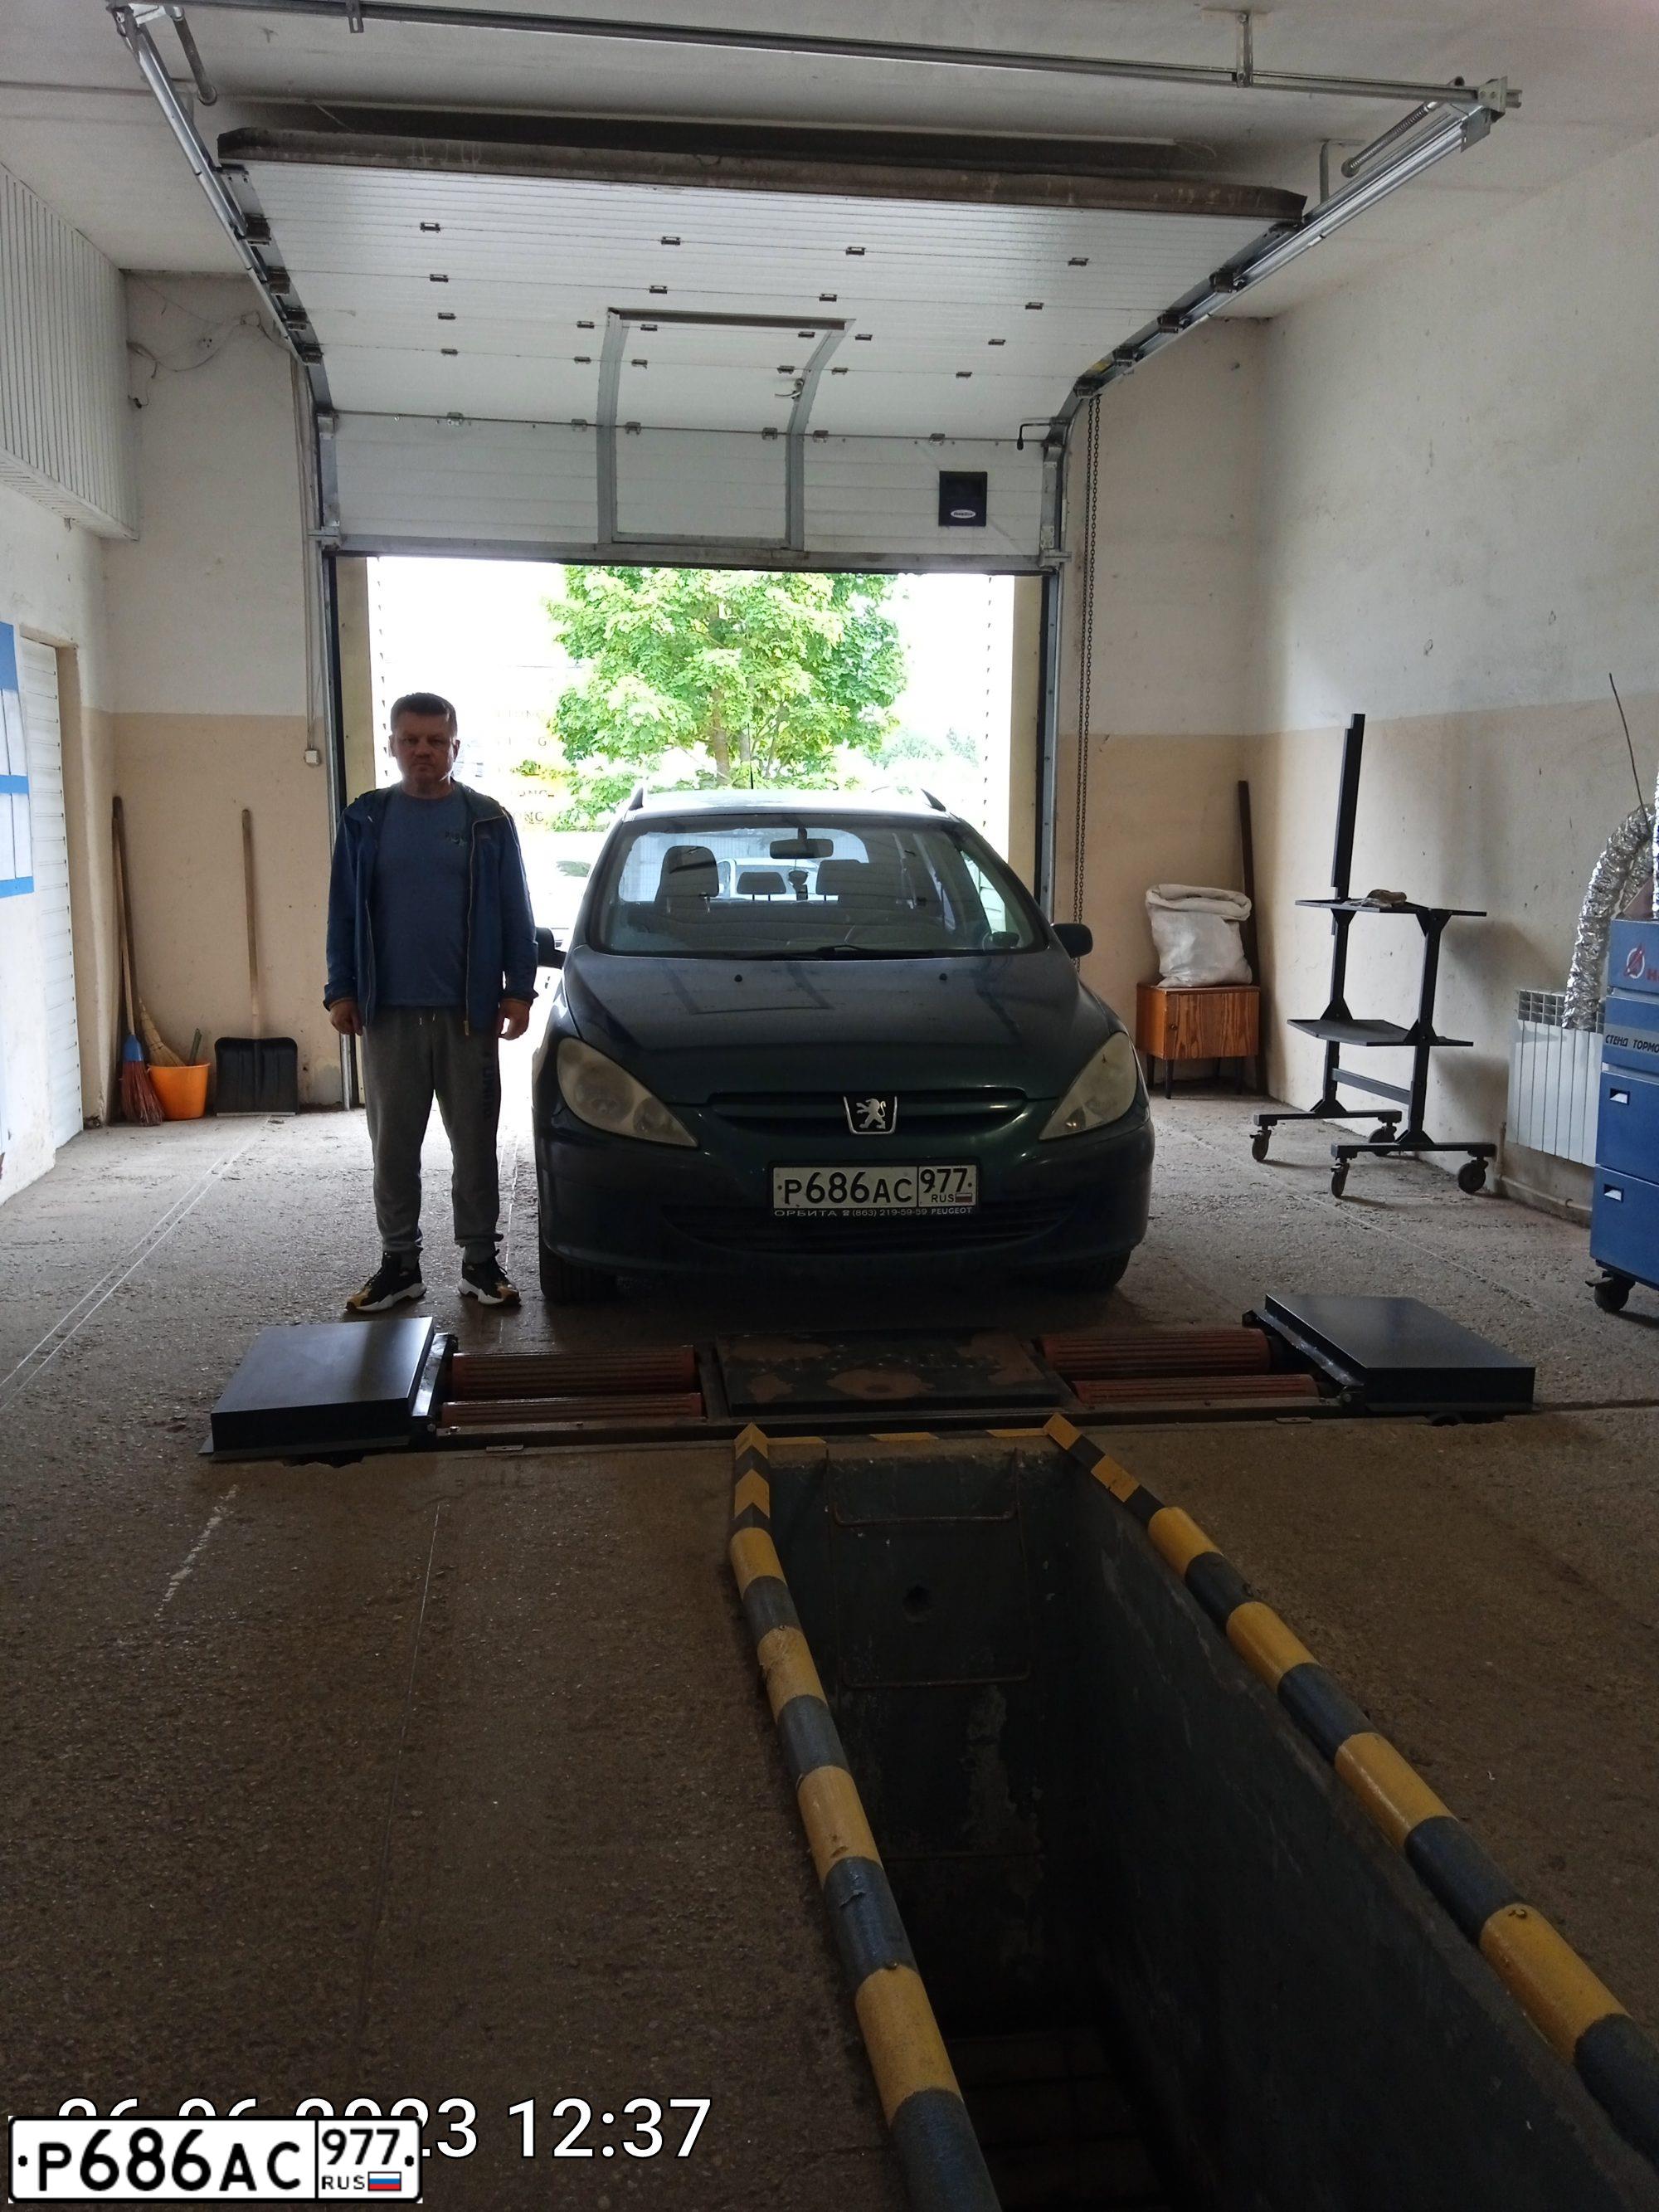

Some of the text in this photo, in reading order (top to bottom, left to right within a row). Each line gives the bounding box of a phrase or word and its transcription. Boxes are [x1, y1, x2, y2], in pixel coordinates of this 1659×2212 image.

[1605, 1034, 1659, 1053] СТЕНД ТОРМО
[784, 1167, 968, 1205] Р686АС 977
[931, 1193, 955, 1203] RUS
[853, 1209, 877, 1217] (863)
